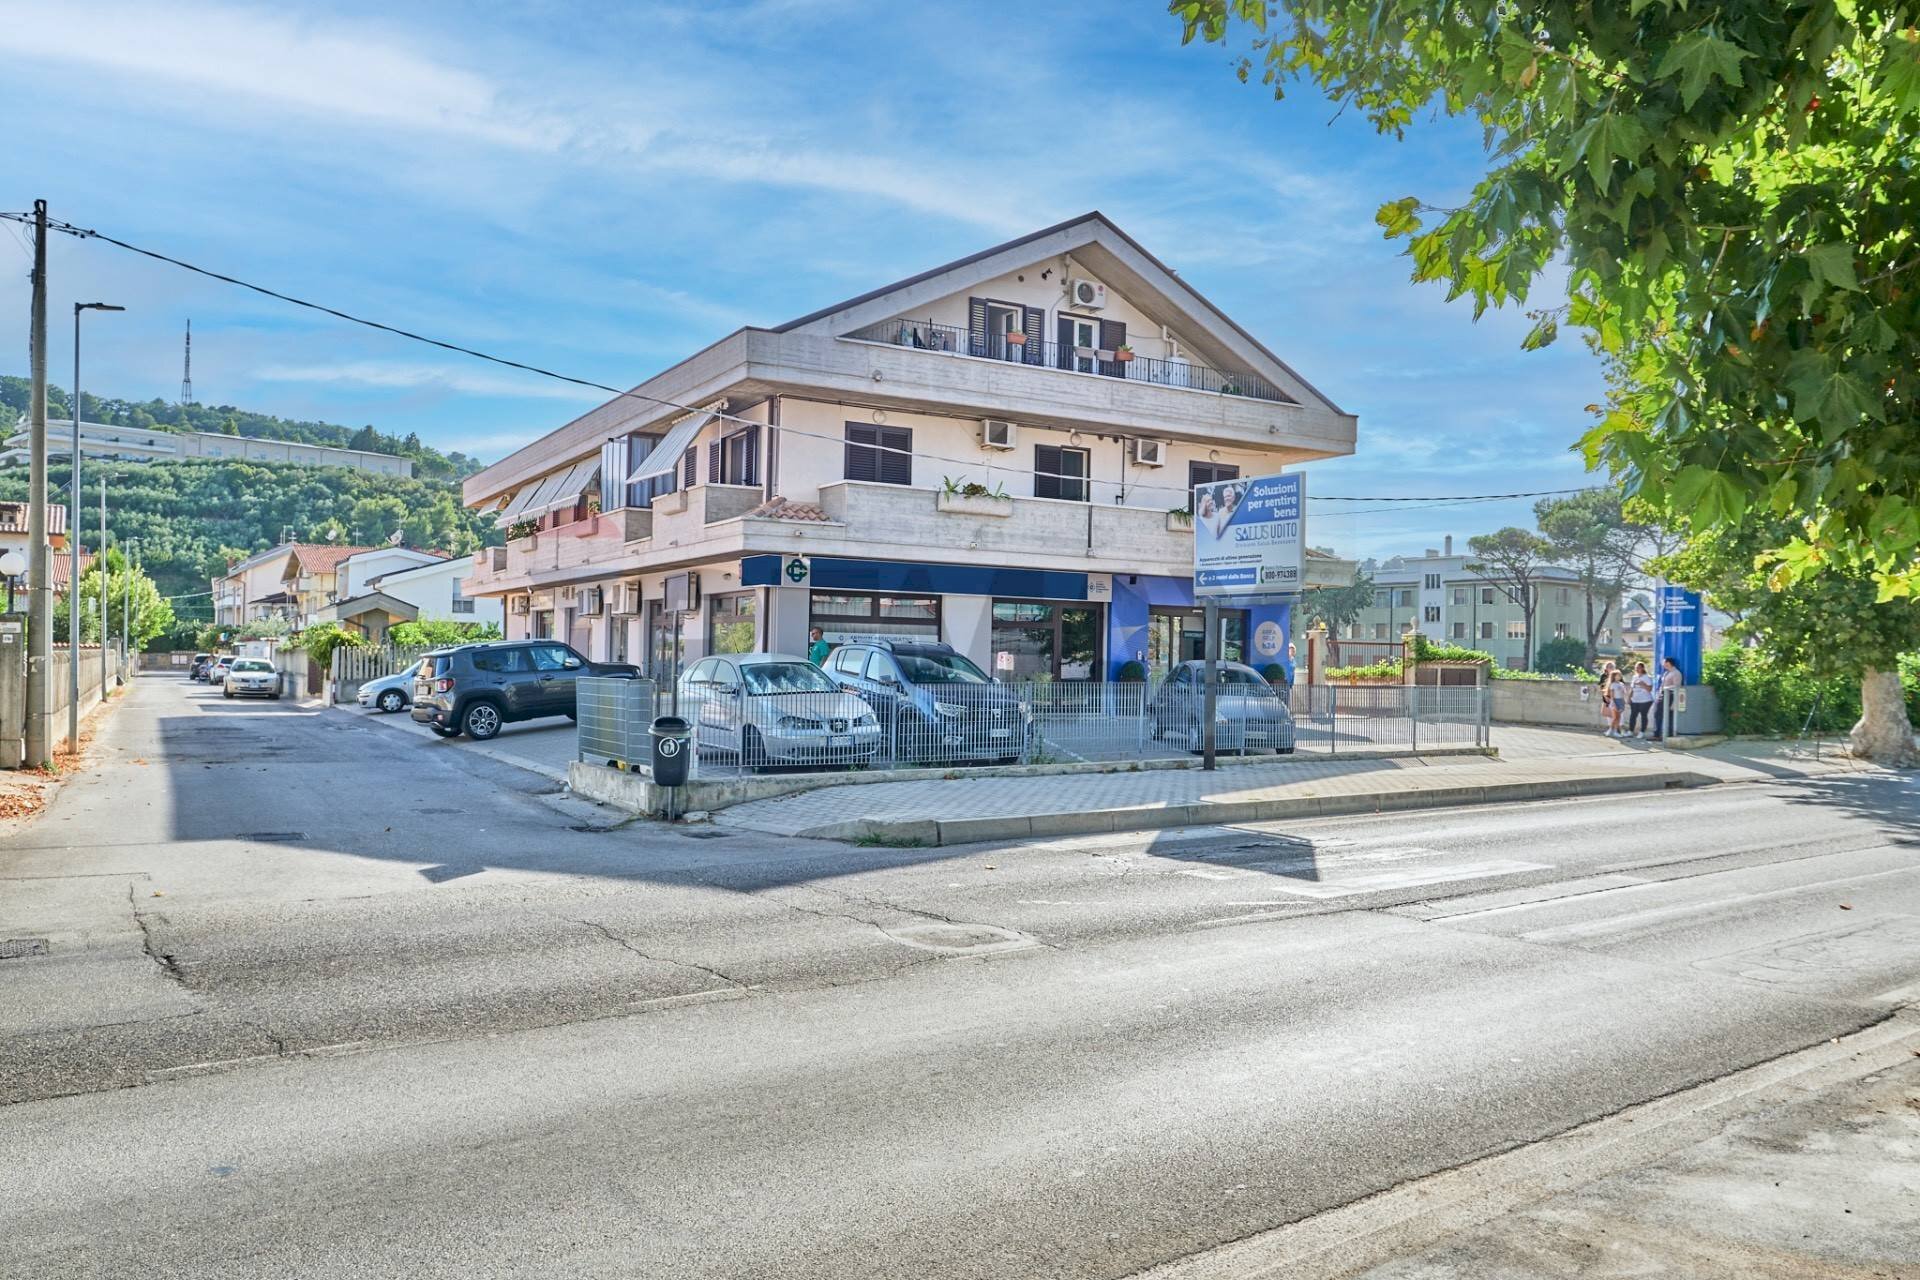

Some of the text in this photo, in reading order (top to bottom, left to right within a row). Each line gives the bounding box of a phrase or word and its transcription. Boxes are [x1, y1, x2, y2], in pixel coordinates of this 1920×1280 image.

[1253, 482, 1297, 497] Soluzioni
[1247, 495, 1297, 512] per sentire
[1273, 507, 1297, 518] bene
[1235, 522, 1297, 541] SALUS UDITO
